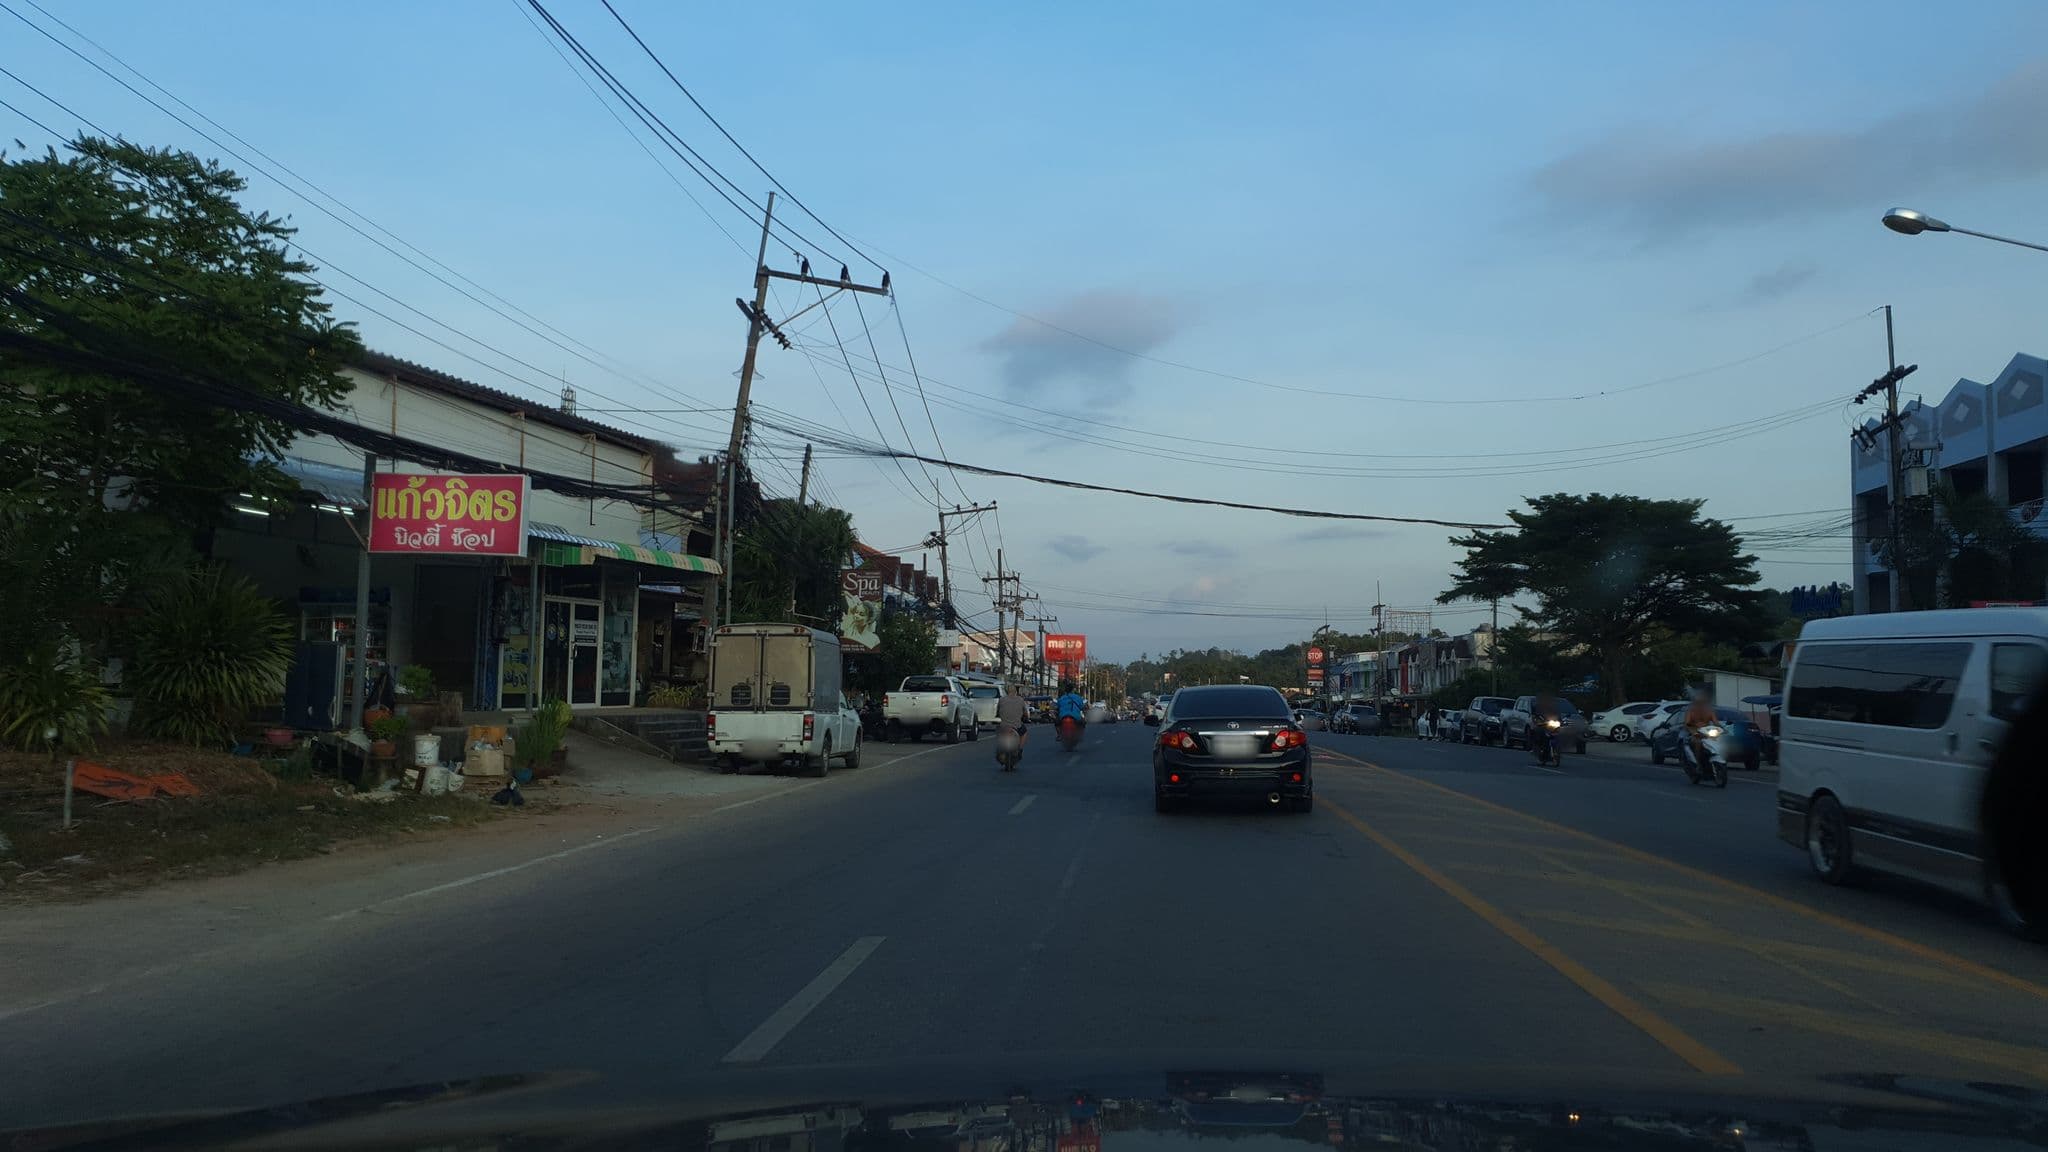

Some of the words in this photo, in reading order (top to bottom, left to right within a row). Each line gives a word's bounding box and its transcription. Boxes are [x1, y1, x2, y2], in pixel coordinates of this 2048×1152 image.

[377, 476, 517, 522] แก้วจิตร
[843, 573, 880, 598] Spa
[1307, 652, 1323, 660] STOP
